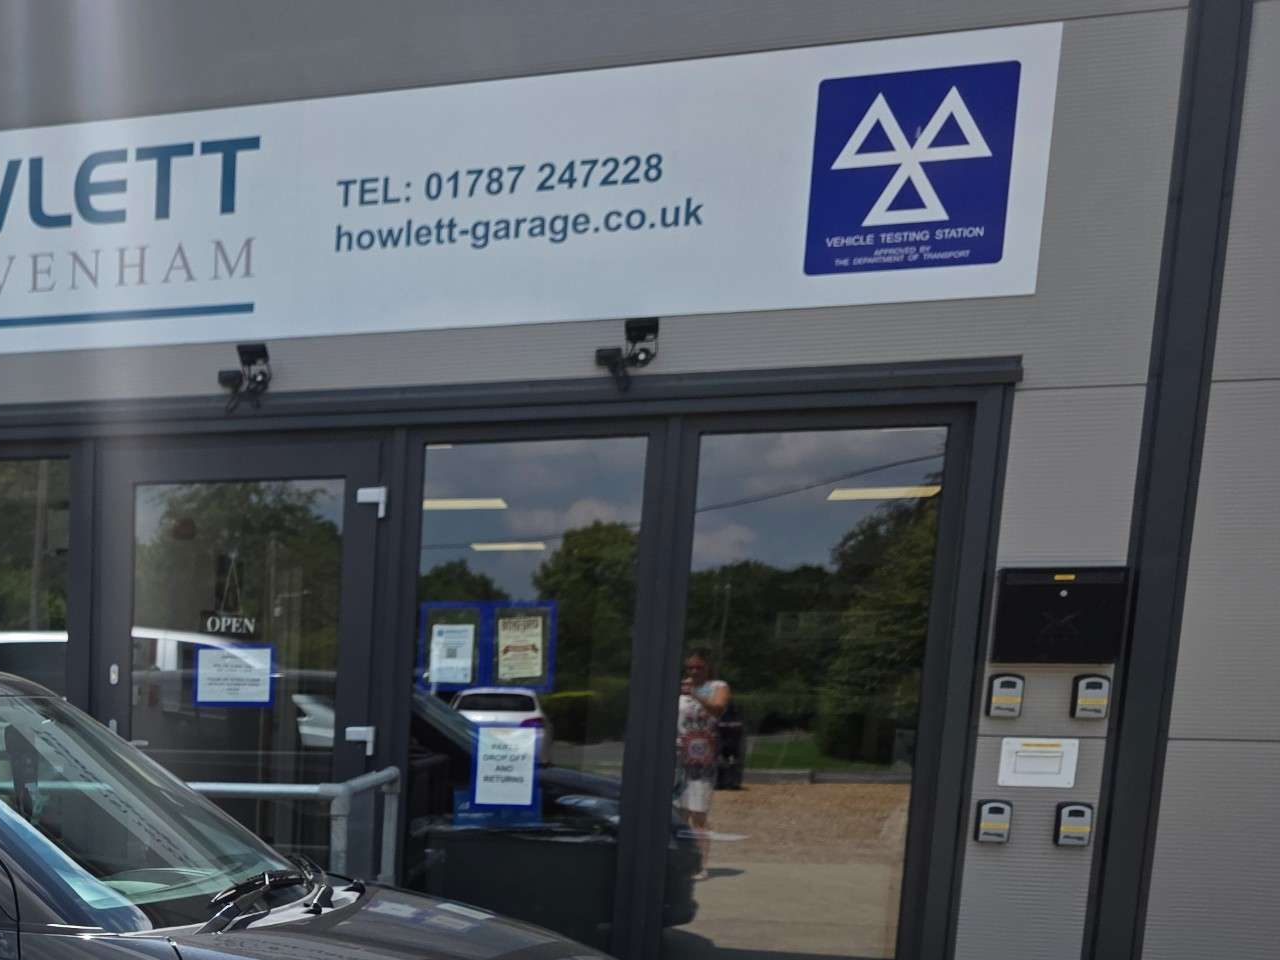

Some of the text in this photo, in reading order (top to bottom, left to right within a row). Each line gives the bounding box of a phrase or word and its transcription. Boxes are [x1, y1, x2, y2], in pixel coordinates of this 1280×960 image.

[337, 152, 665, 208] TEL: 01787 247228
[334, 197, 704, 254] howlett-garage.co.uk
[826, 226, 985, 248] VEHICLE TESTING STATION
[834, 249, 971, 267] THE DEPARTMENT OF TRANSPORT
[206, 616, 256, 633] OPEN
